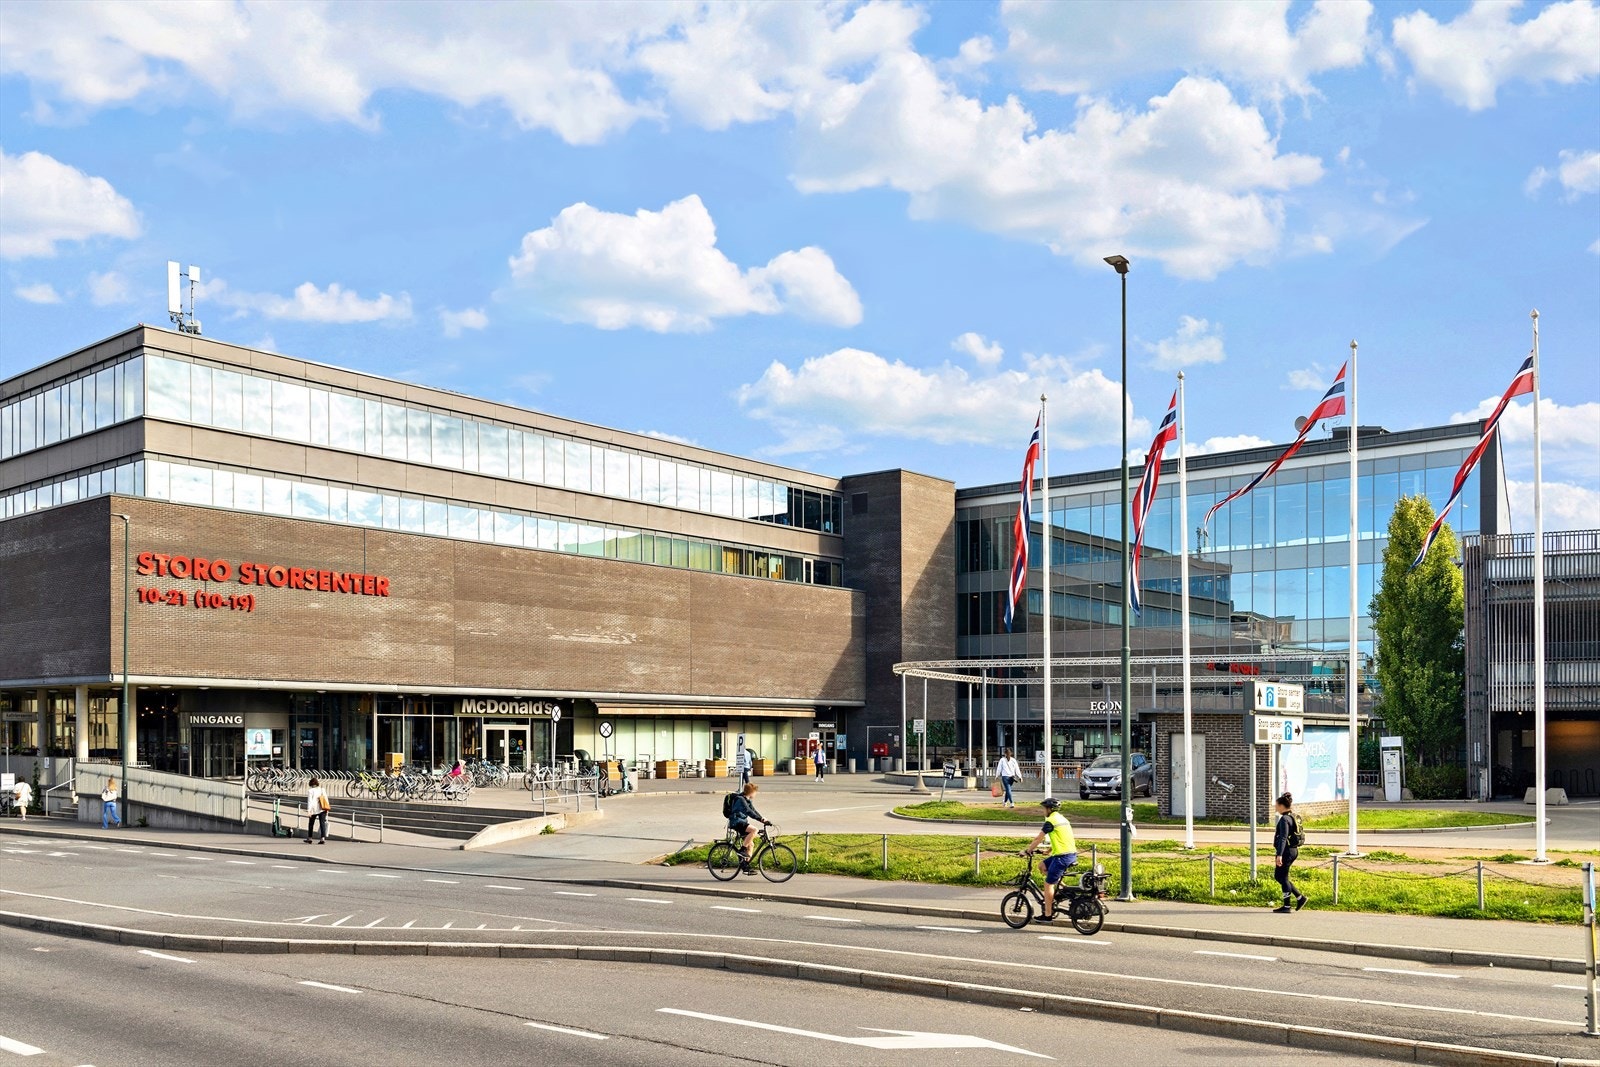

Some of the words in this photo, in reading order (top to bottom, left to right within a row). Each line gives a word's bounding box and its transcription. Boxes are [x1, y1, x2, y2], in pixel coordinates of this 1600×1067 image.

[137, 552, 231, 582] STORO
[239, 562, 390, 597] STORSENTER
[137, 587, 188, 606] 10-21
[194, 590, 256, 612] (10-19)
[1277, 687, 1287, 696] Storo
[461, 699, 553, 715] McDonald's
[1090, 701, 1122, 711] EGON
[189, 715, 243, 724] INNGANG
[1258, 718, 1268, 728] Storo
[738, 736, 743, 752] P
